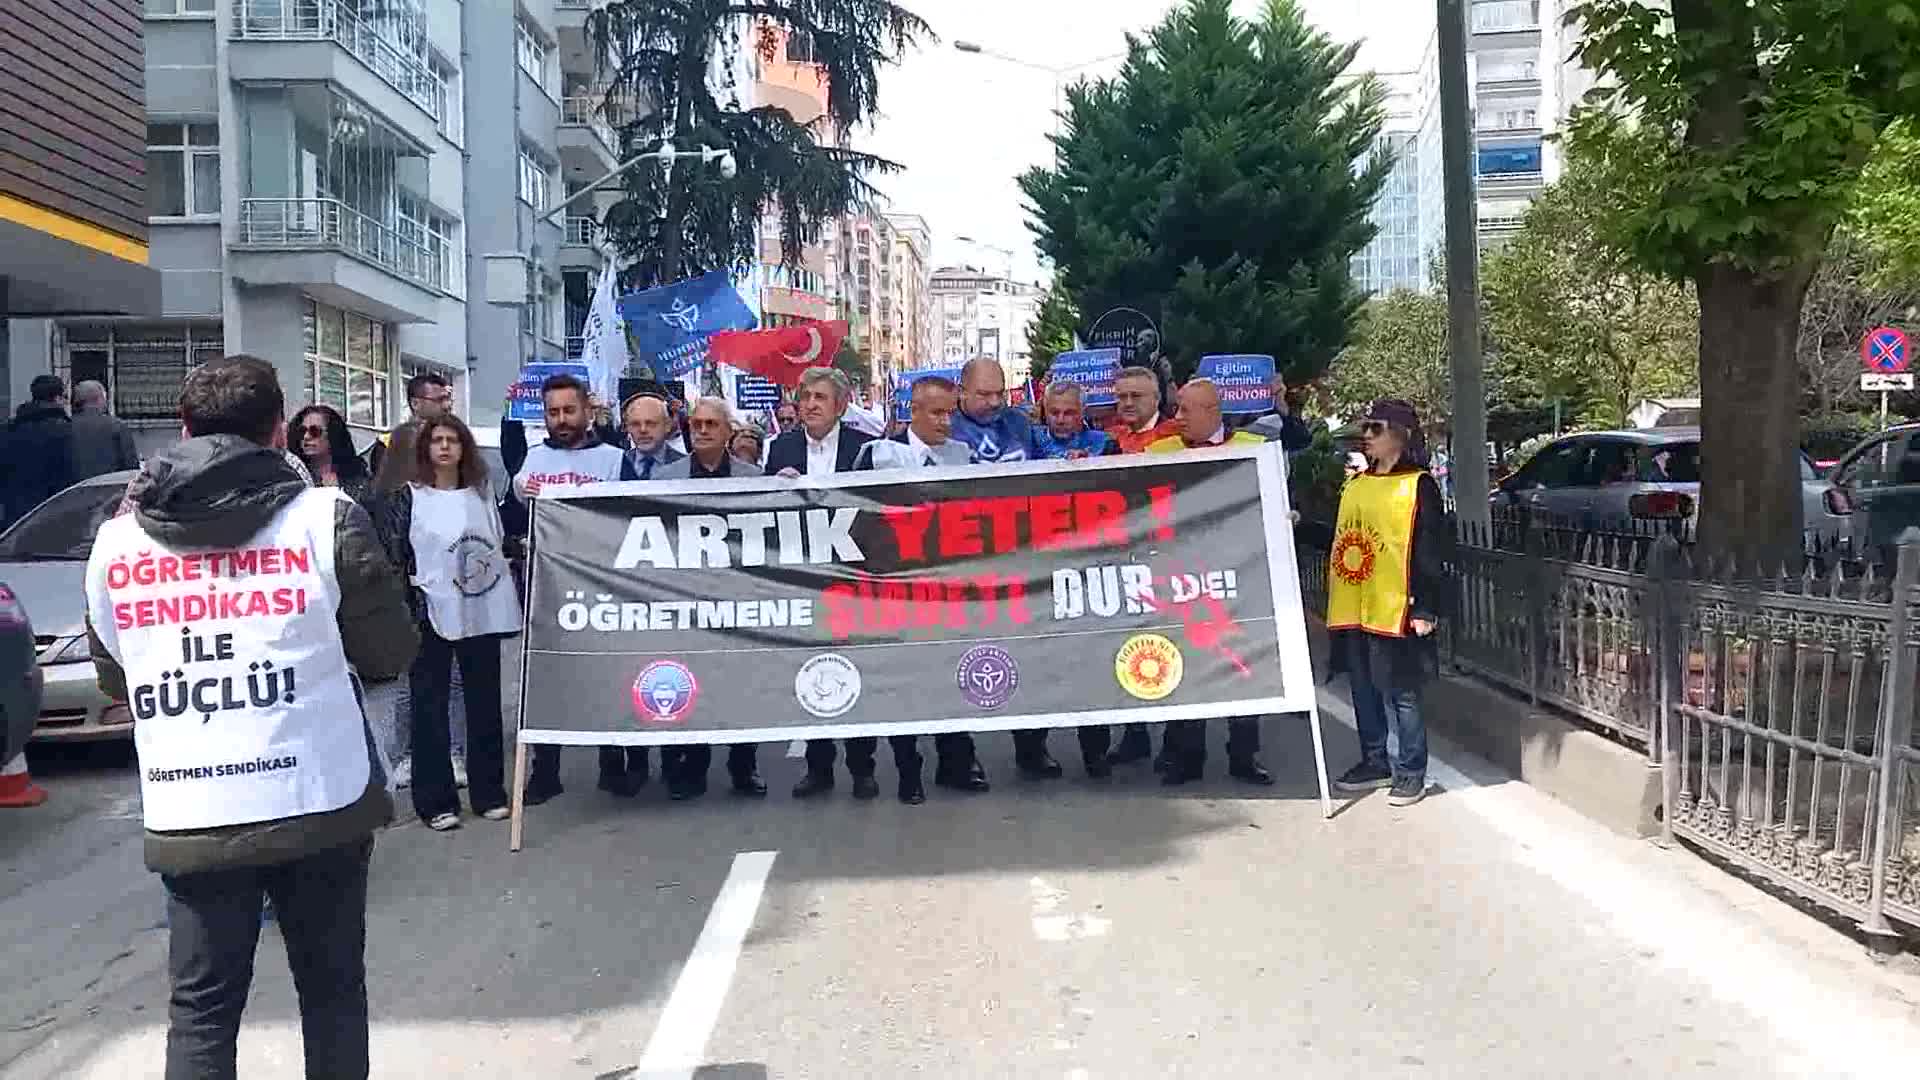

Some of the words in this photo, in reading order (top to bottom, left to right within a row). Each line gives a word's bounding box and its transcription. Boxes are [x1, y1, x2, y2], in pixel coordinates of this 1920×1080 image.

[1215, 361, 1252, 375] Eğitim
[613, 507, 865, 570] ARTIK
[881, 490, 1128, 561] YETER
[1147, 482, 1176, 542] !
[106, 546, 310, 590] ÖĞRETMEN
[114, 583, 306, 631] SENDİKASI
[557, 591, 814, 632] ÖĞRETMENE
[1053, 562, 1158, 621] DUR
[181, 626, 235, 664] İLE
[133, 660, 296, 725] GÜÇLÜ!
[148, 765, 213, 783] ÖĞRETMEN
[216, 756, 297, 777] SENDİKASI
